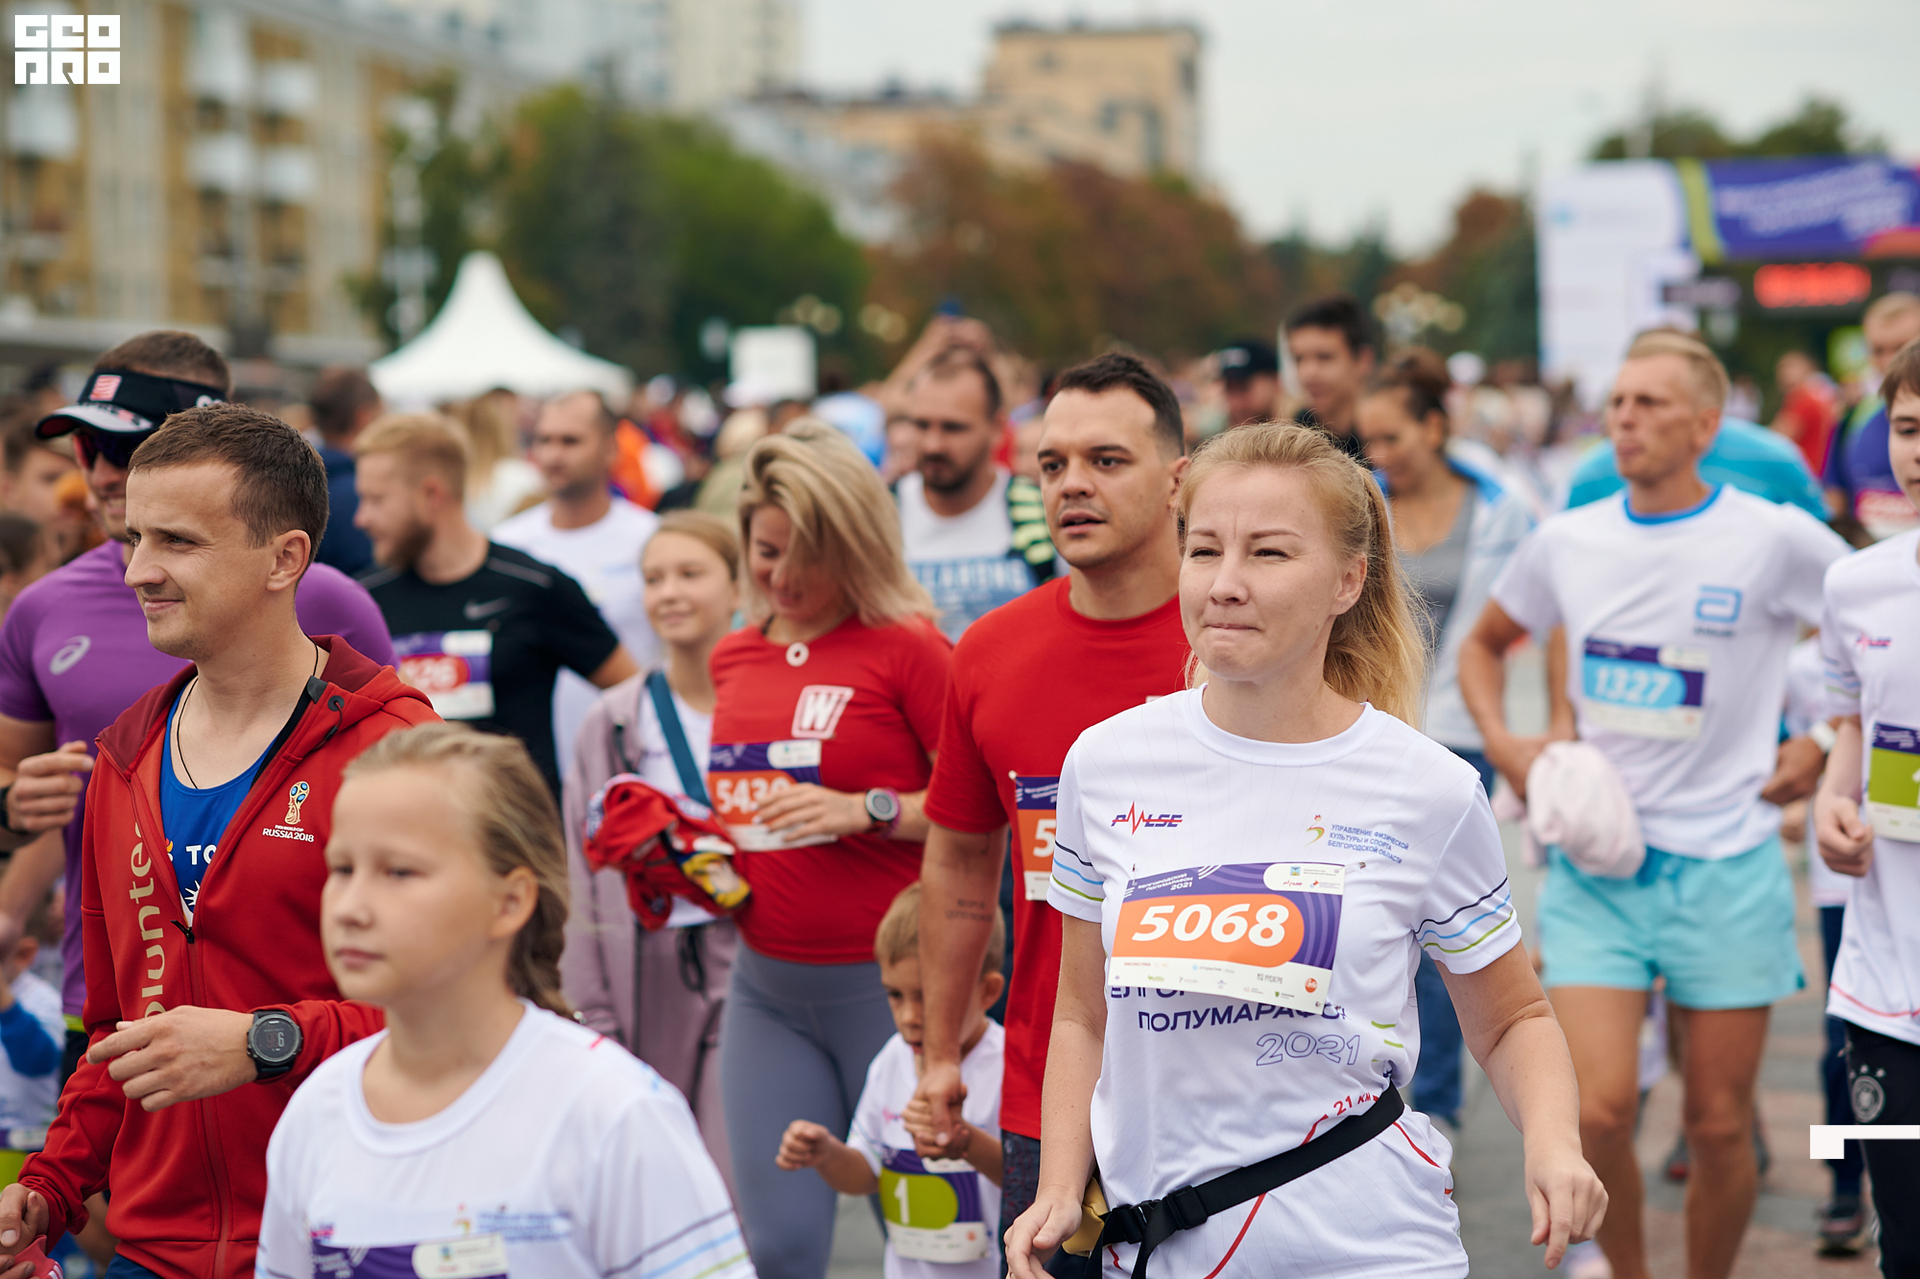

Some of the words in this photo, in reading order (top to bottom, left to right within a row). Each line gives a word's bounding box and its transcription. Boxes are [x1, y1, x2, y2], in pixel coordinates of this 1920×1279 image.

[1595, 666, 1672, 704] 1327
[262, 828, 293, 839] RUSSIA
[294, 832, 315, 842] 2018
[1329, 832, 1363, 843] КУЛЬТУРЫ
[1370, 838, 1392, 851] СПОРТА
[1331, 824, 1373, 837] УПРАВЛЕНИЕ
[1374, 831, 1409, 850] ФИЗИЧЕСКОЙ
[1327, 840, 1379, 853] БЕЛГОРОДСКОЙ
[1379, 848, 1403, 864] ОБЛАСТИ
[1170, 881, 1193, 891] 2021
[1131, 903, 1290, 947] 5068
[1256, 1031, 1360, 1066] 2021
[1333, 1095, 1353, 1116] 21
[894, 1177, 910, 1224] 1
